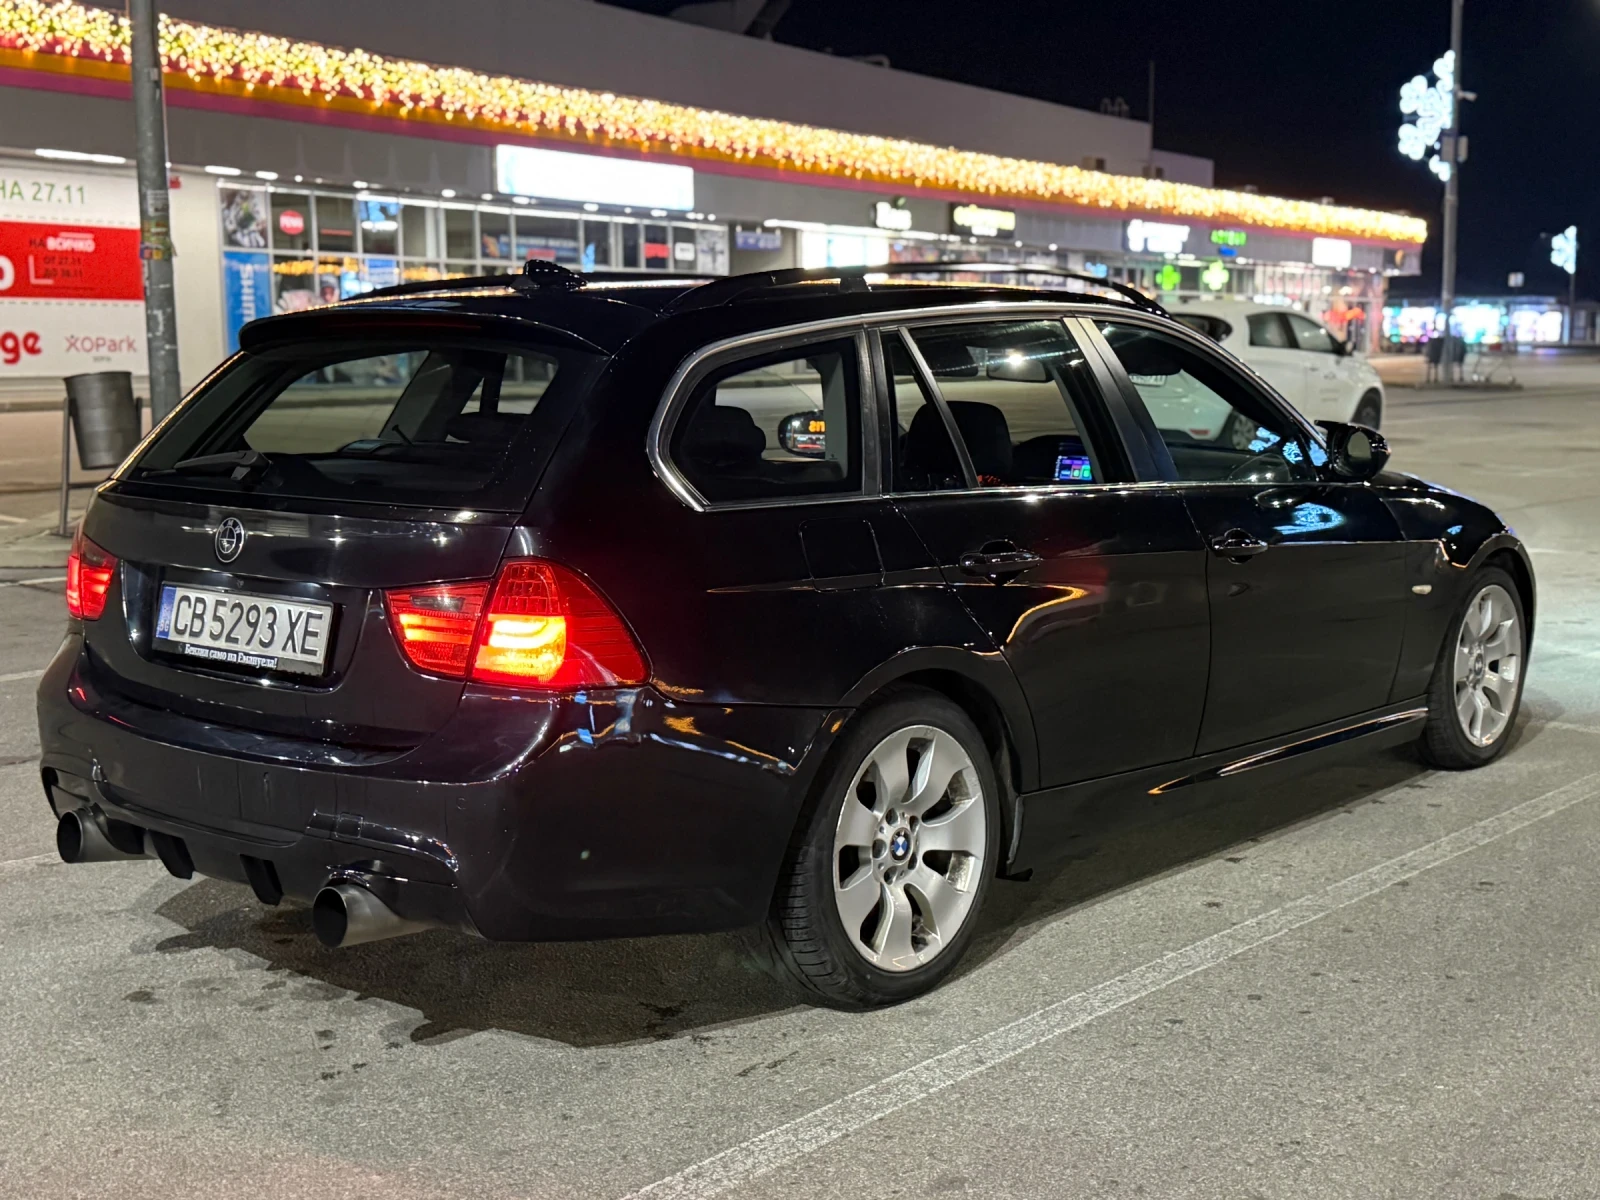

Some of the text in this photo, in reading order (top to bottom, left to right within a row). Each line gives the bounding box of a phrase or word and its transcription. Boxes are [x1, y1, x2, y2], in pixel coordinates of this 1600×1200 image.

[31, 182, 85, 204] 27.11
[209, 599, 279, 649] 5293
[281, 608, 324, 657] XE
